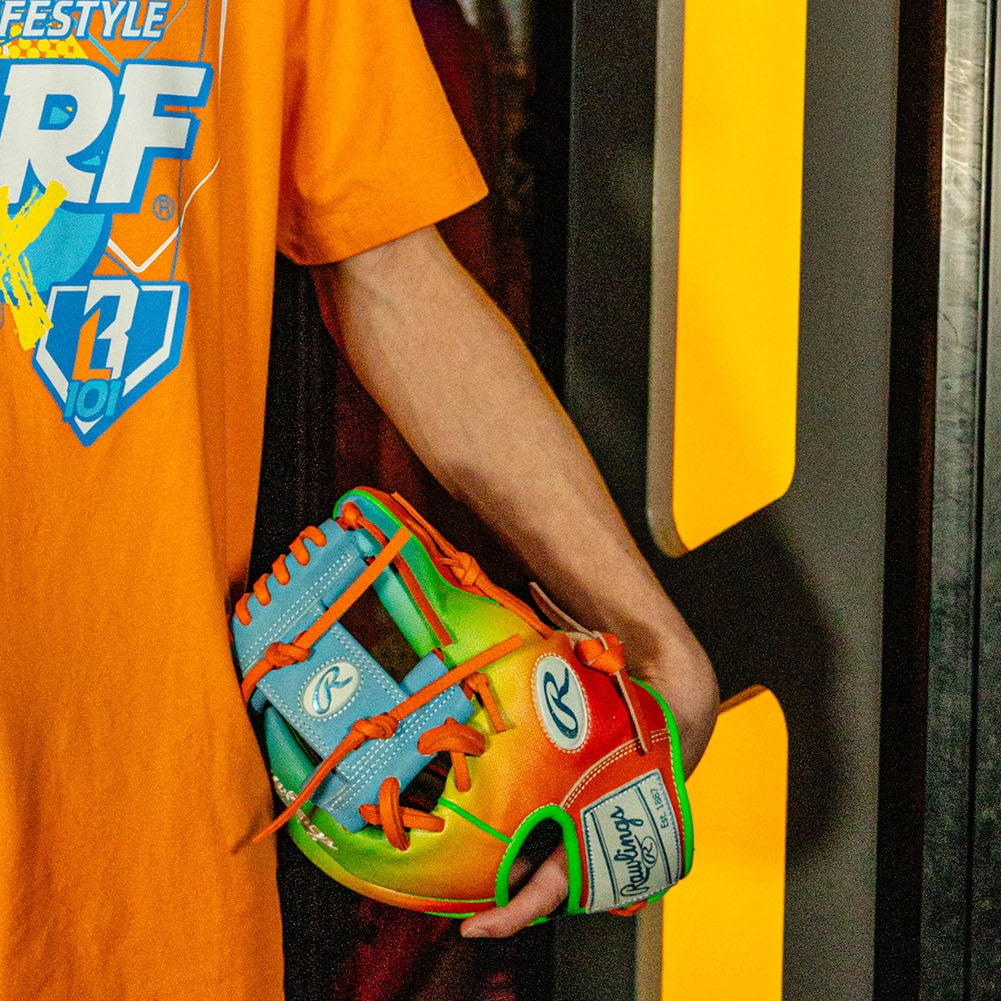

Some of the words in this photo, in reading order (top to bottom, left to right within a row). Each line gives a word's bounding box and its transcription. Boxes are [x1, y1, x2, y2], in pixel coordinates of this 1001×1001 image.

[312, 665, 353, 716] R
[543, 666, 579, 740] R
[610, 805, 649, 898] Rawlings
